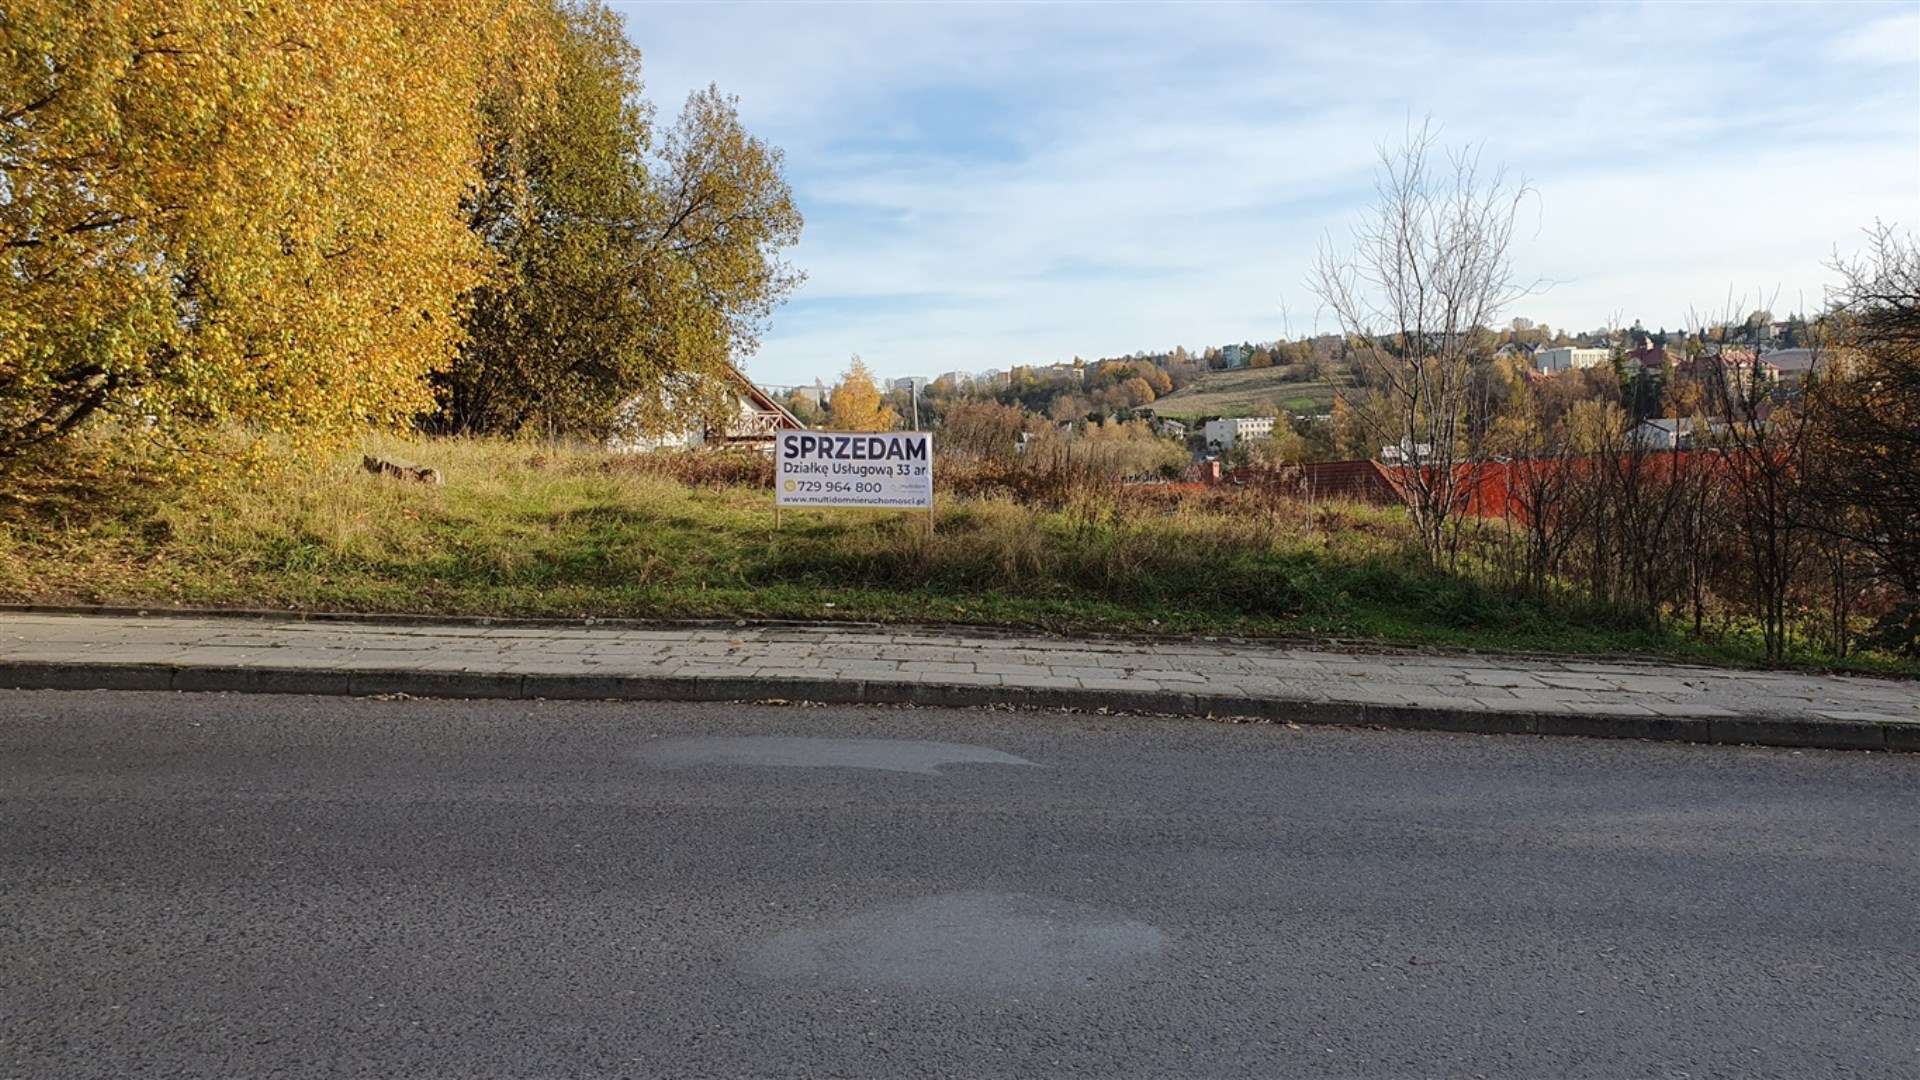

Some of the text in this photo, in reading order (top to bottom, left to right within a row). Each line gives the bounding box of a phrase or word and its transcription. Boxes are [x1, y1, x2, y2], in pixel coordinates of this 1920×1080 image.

[784, 435, 926, 461] SPRZEDAM
[783, 462, 926, 479] Działkę Usługową 33 ar
[797, 481, 882, 493] 729 964 800
[783, 495, 926, 506] www.multidomnieruchomosci.pl
